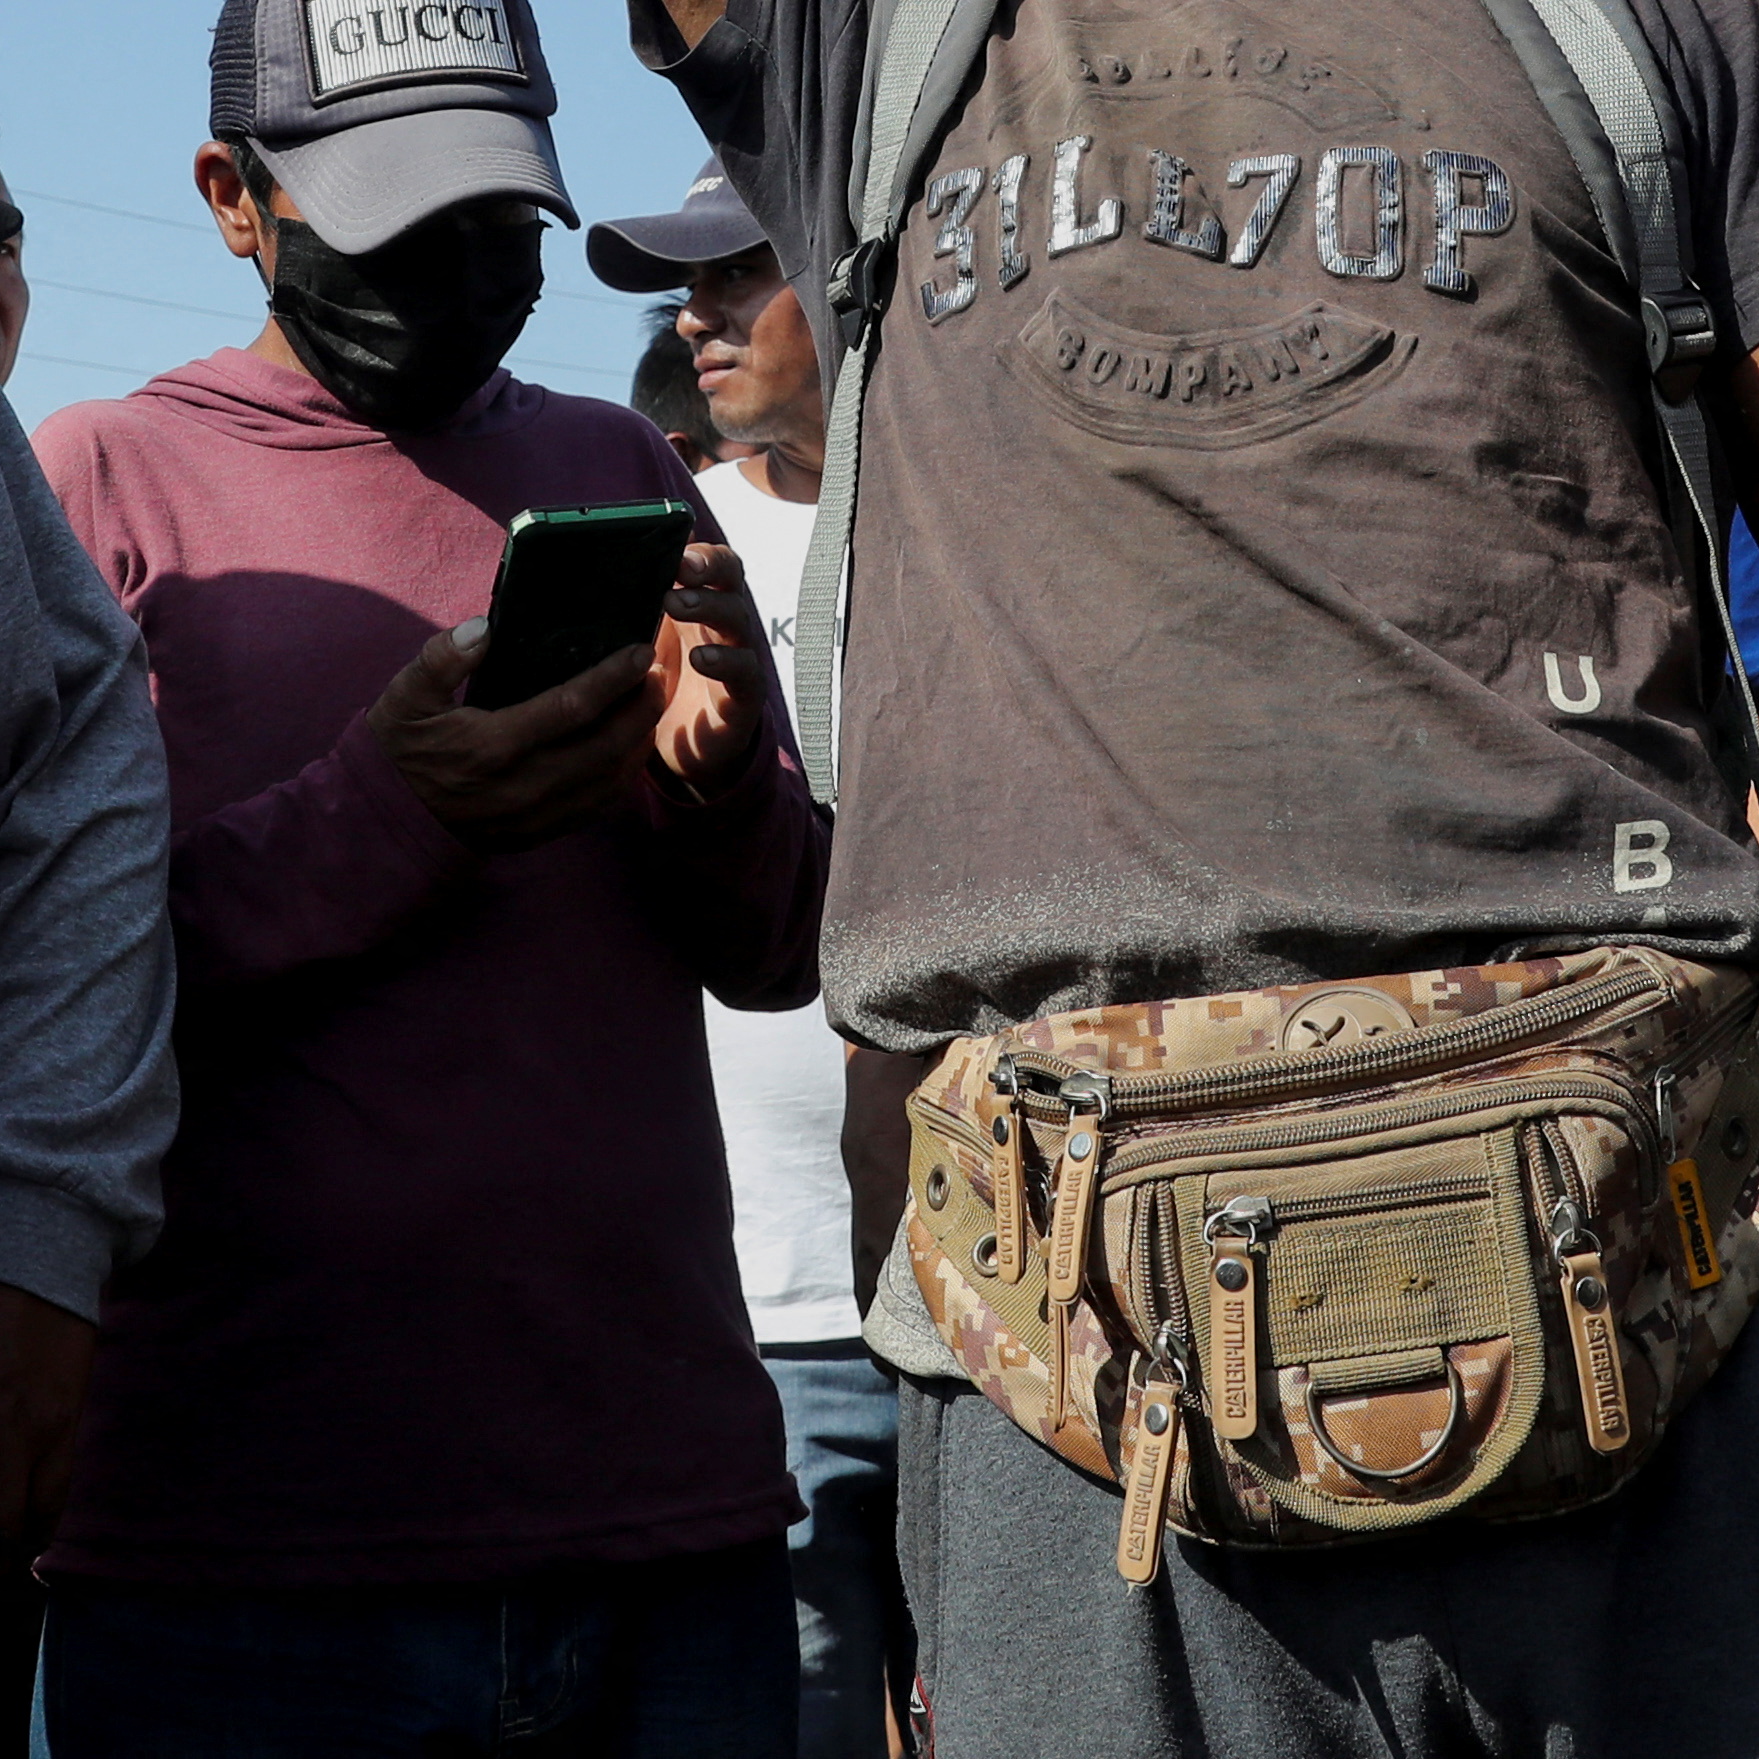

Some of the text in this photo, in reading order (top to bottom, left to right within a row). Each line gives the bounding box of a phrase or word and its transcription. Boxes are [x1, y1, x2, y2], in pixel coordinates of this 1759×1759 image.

[329, 4, 505, 56] GUCCI
[1053, 320, 1332, 403] COMPANY
[1543, 651, 1601, 714] U
[1612, 818, 1673, 893] B
[1054, 1168, 1085, 1280] CATERPILLAR
[1223, 1299, 1248, 1419] CATERPILLAR
[1583, 1314, 1621, 1432] CATERPILLAR
[1126, 1443, 1162, 1562] CATERPILLAR
